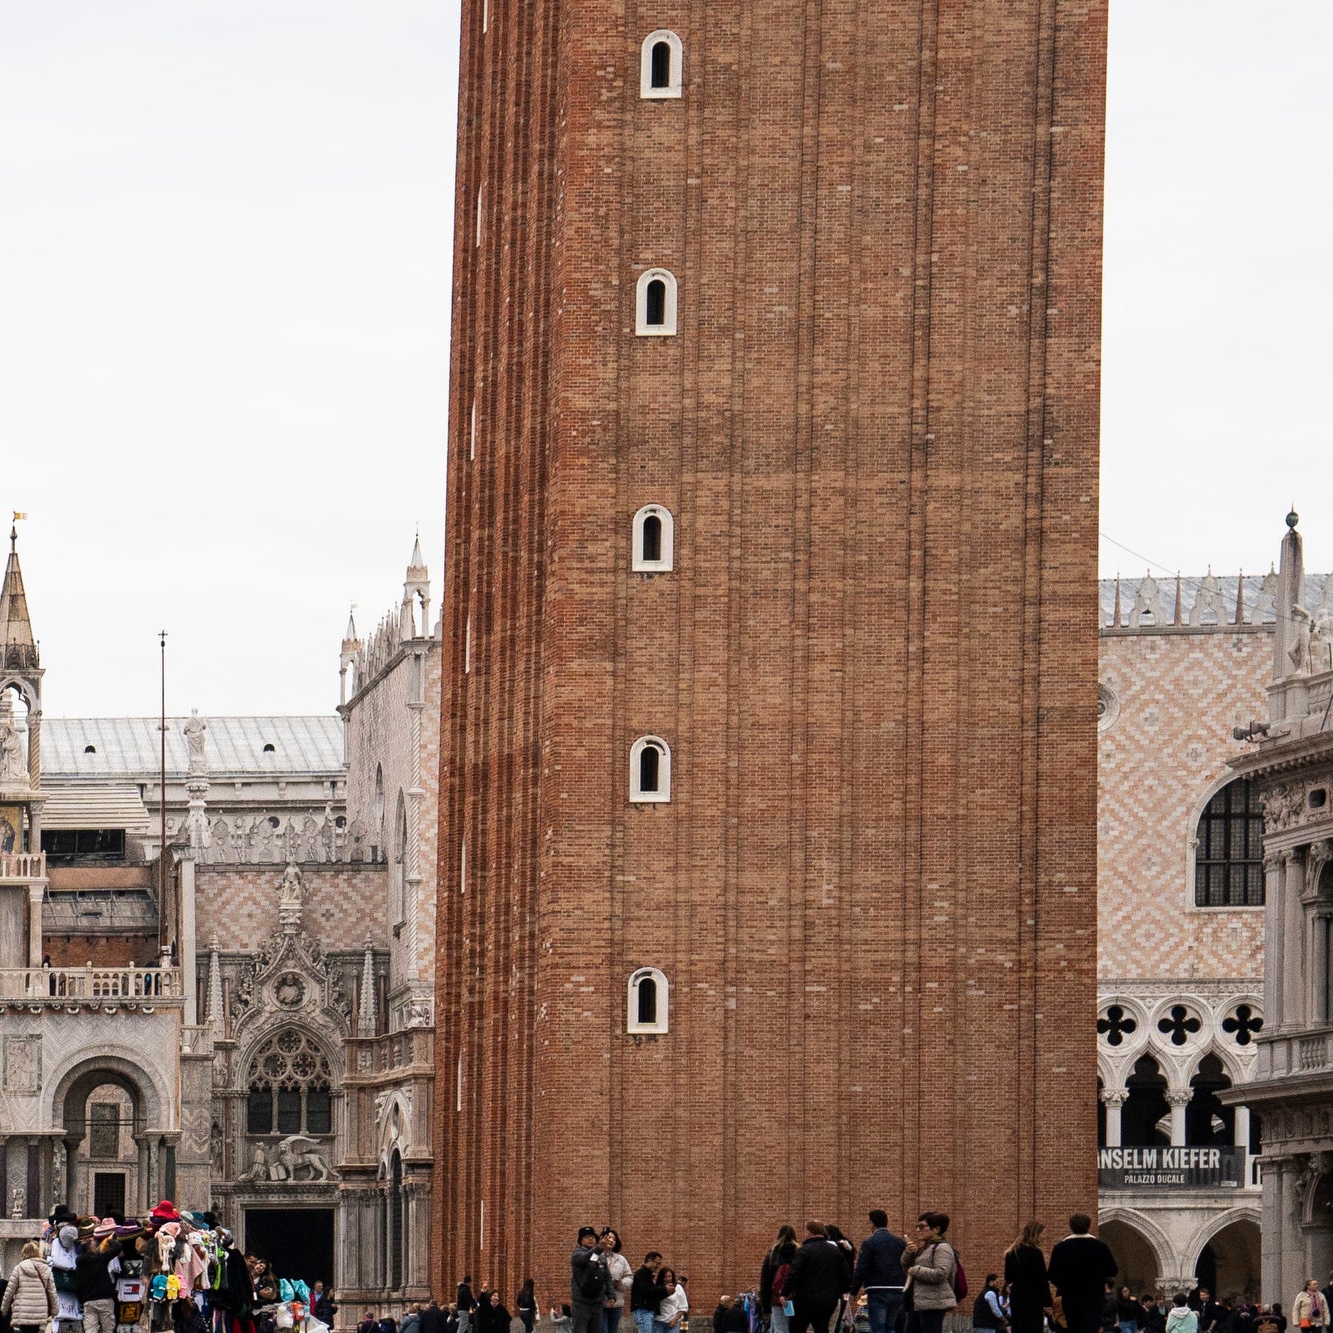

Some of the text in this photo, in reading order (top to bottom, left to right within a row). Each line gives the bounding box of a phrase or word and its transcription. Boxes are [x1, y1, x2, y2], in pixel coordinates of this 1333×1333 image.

[1162, 1148, 1221, 1169] KIEFER
[1124, 1174, 1185, 1184] PALAZZO DUCALE
